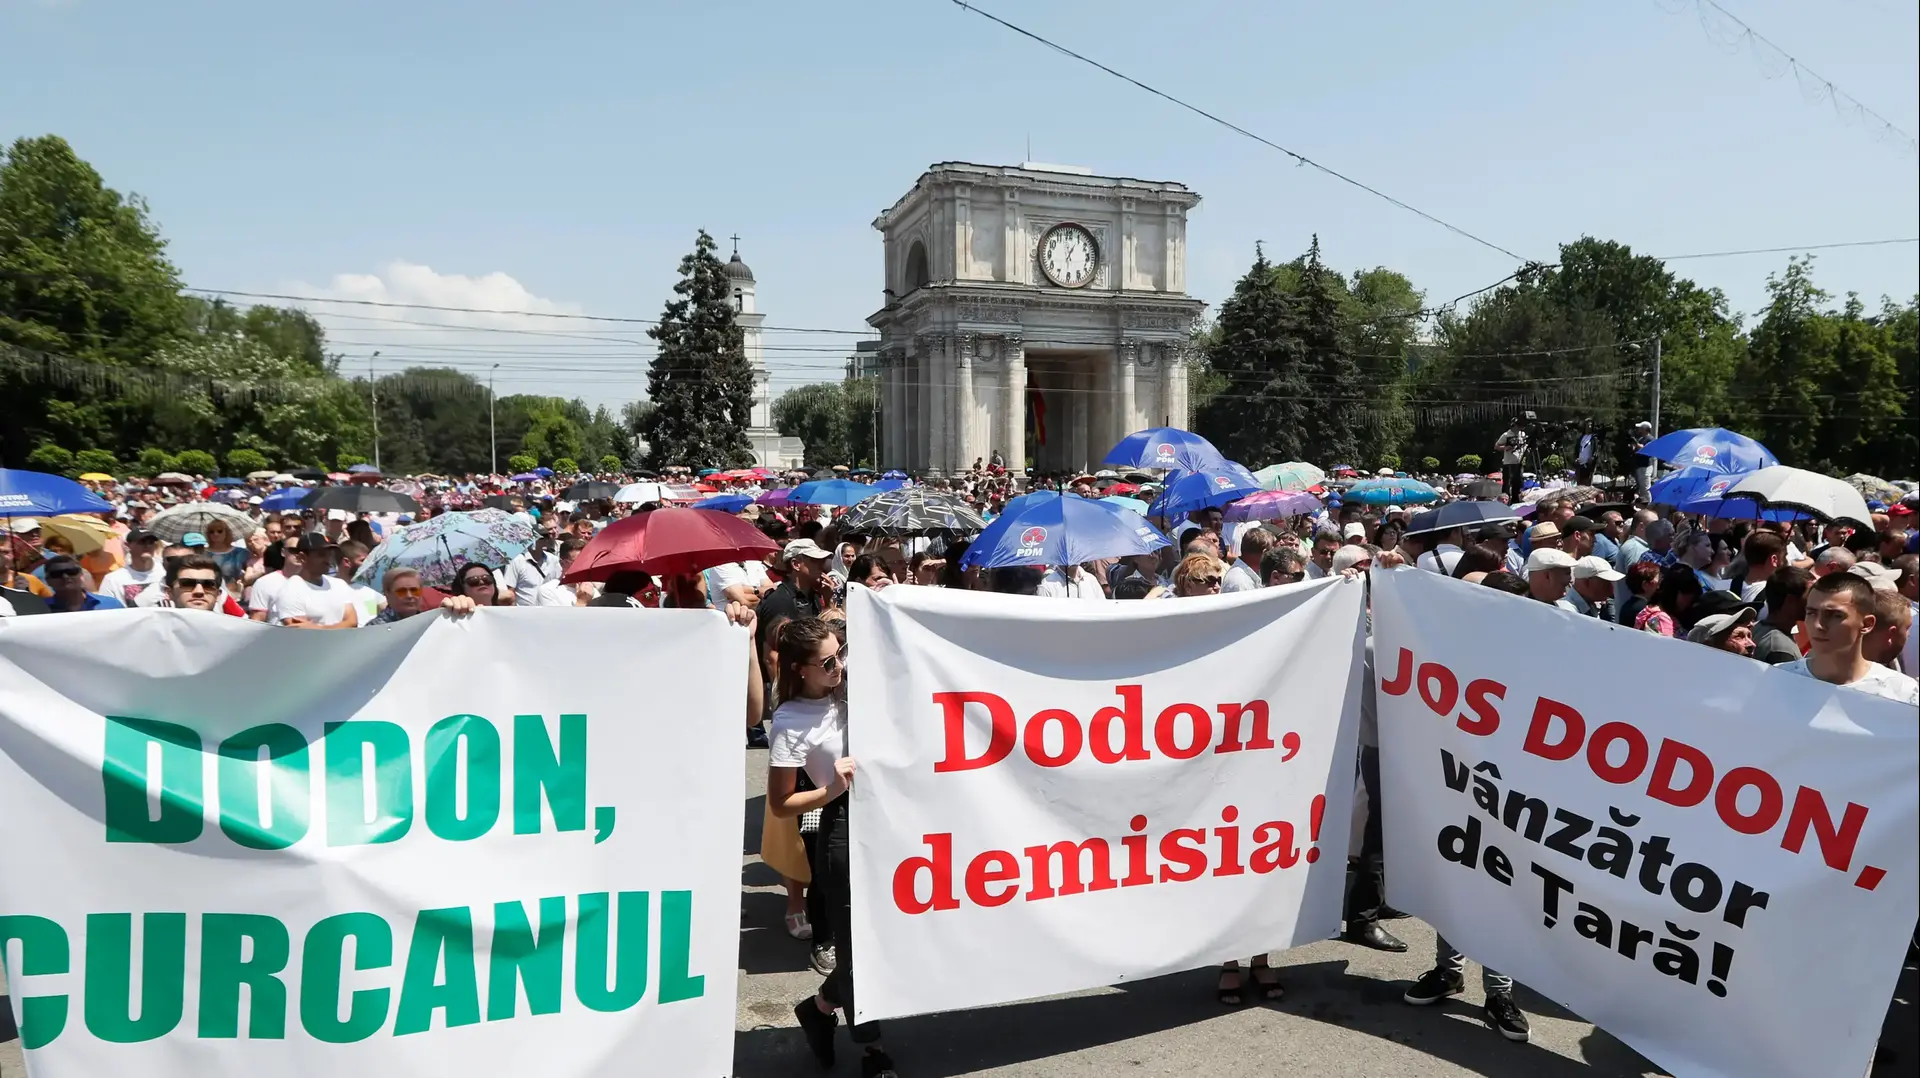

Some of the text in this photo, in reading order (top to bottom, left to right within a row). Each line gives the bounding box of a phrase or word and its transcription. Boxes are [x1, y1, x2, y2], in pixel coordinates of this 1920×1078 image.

[1050, 240, 1056, 250] 10
[1692, 457, 1714, 466] PDM
[1016, 547, 1043, 557] PDM
[102, 714, 616, 851] DODON,
[932, 684, 1301, 774] Dodon,
[1381, 646, 1888, 892] JOS DODON,
[892, 793, 1327, 916] demisia!
[1440, 747, 1770, 929] vânzător
[0, 890, 705, 1051] CURCANUL
[1437, 815, 1735, 999] de Țară!
